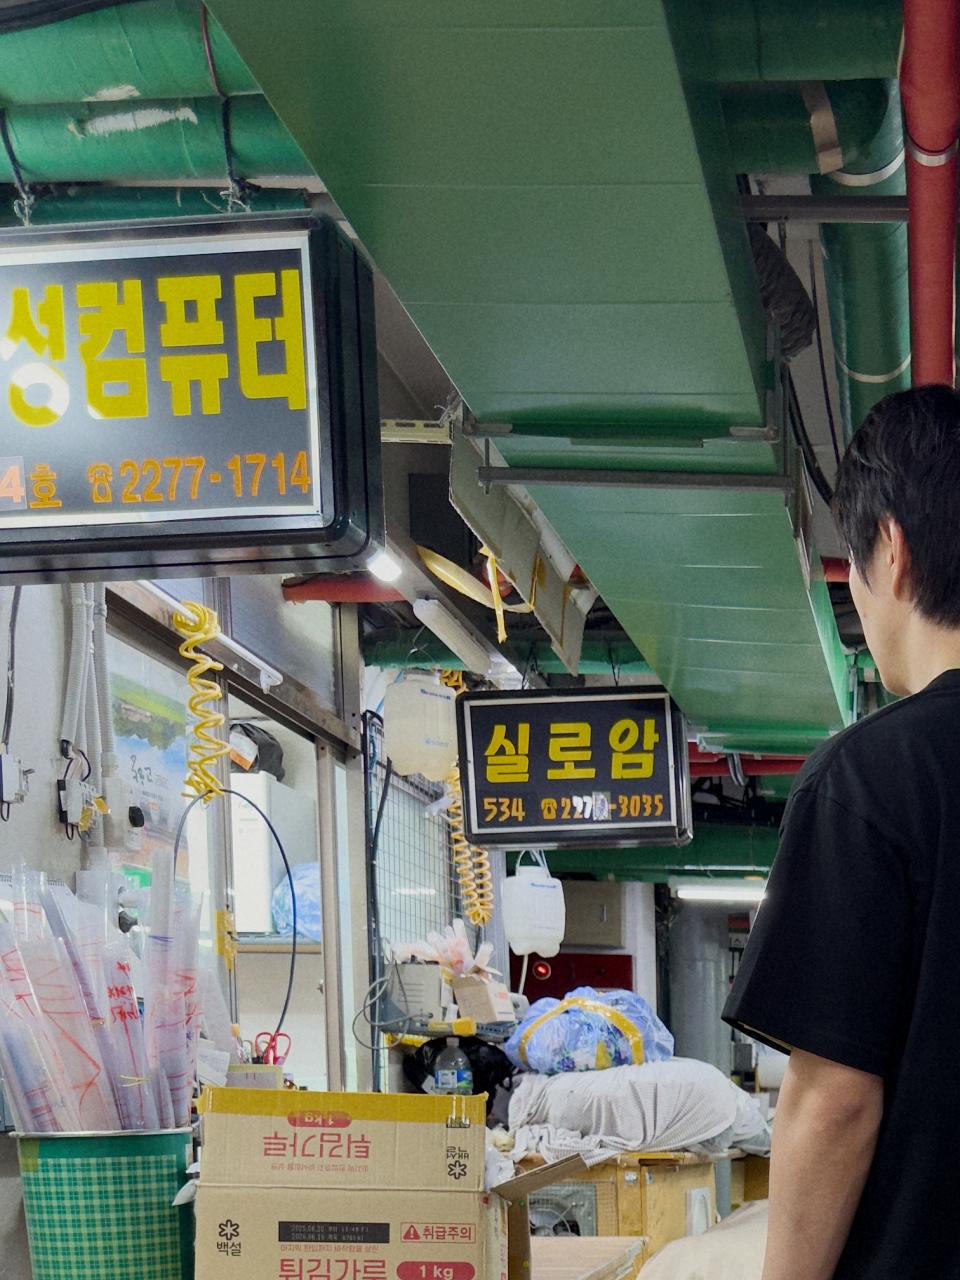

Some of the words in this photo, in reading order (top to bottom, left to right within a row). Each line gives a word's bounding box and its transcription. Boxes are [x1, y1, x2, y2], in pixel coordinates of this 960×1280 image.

[0, 268, 307, 427] 성컴퓨터
[120, 451, 311, 504] 2277-1714
[484, 718, 659, 783] 실로암
[483, 797, 525, 823] 534
[262, 1132, 372, 1159] 튀김가루
[422, 1226, 472, 1240] 취급주의
[216, 1241, 242, 1256] 백설
[419, 1265, 427, 1279] 1
[432, 1264, 454, 1280] kg
